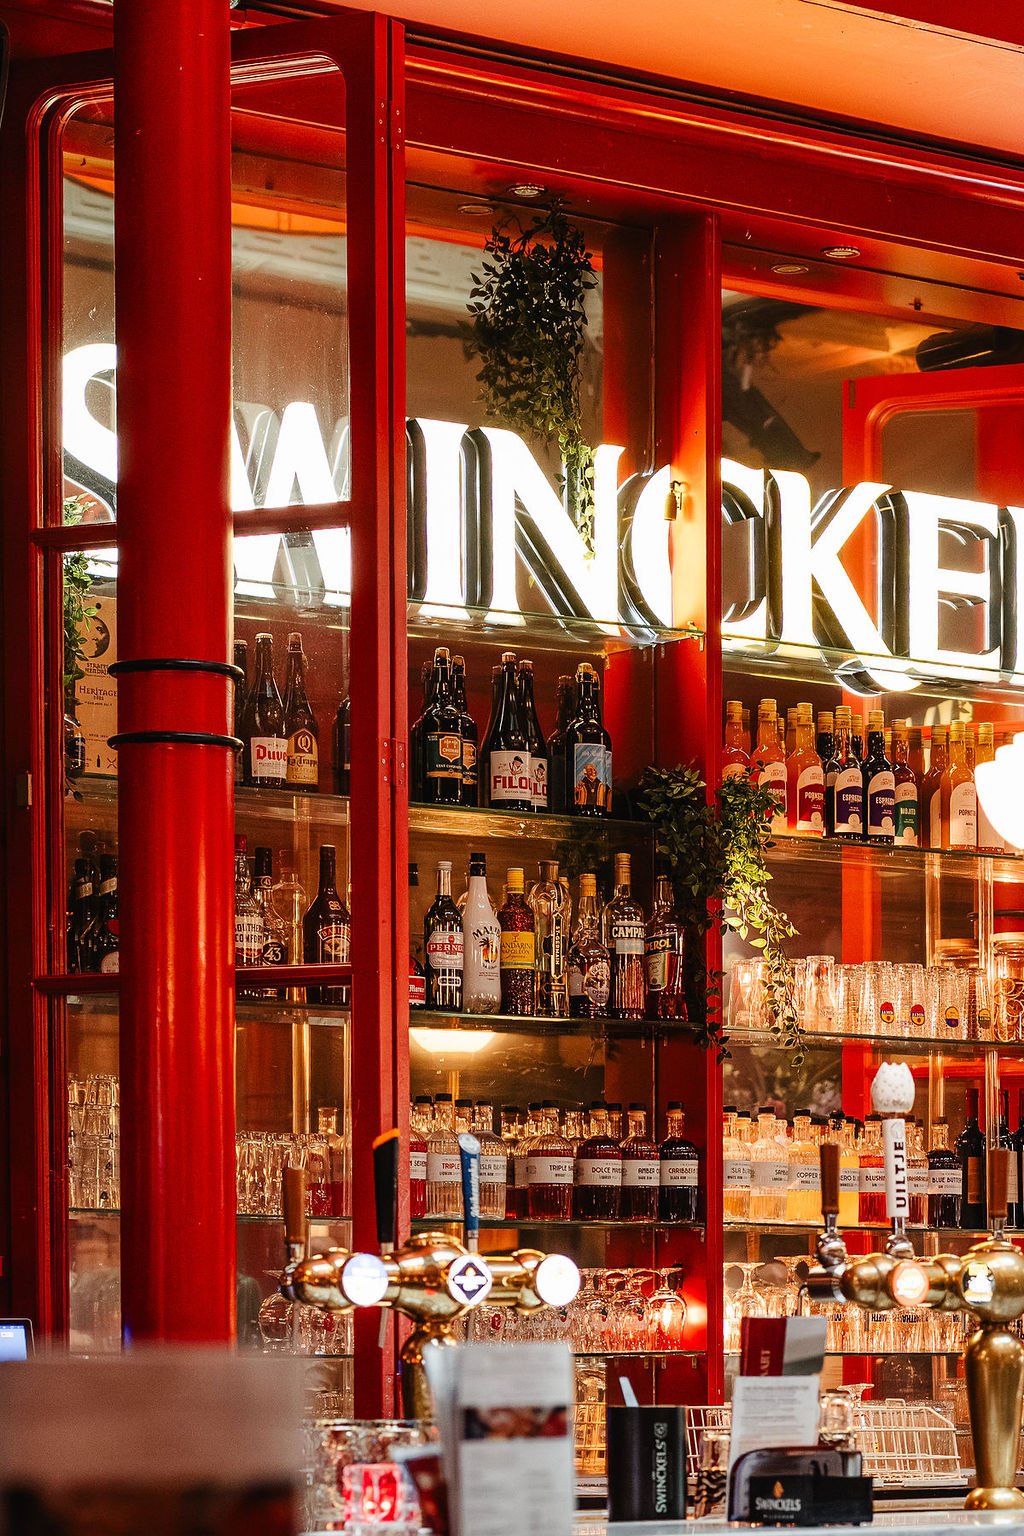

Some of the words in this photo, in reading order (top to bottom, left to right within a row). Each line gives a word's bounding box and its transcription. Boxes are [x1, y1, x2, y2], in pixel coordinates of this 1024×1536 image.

[255, 744, 288, 761] Duve
[296, 755, 318, 767] Trapp
[493, 775, 531, 789] FILO
[263, 946, 282, 962] 43
[441, 1162, 461, 1170] TRIPLE
[549, 1164, 567, 1172] TRIPLE
[591, 1166, 610, 1174] DOLCE
[796, 1171, 818, 1179] COPPER
[894, 1141, 907, 1208] UILTJE
